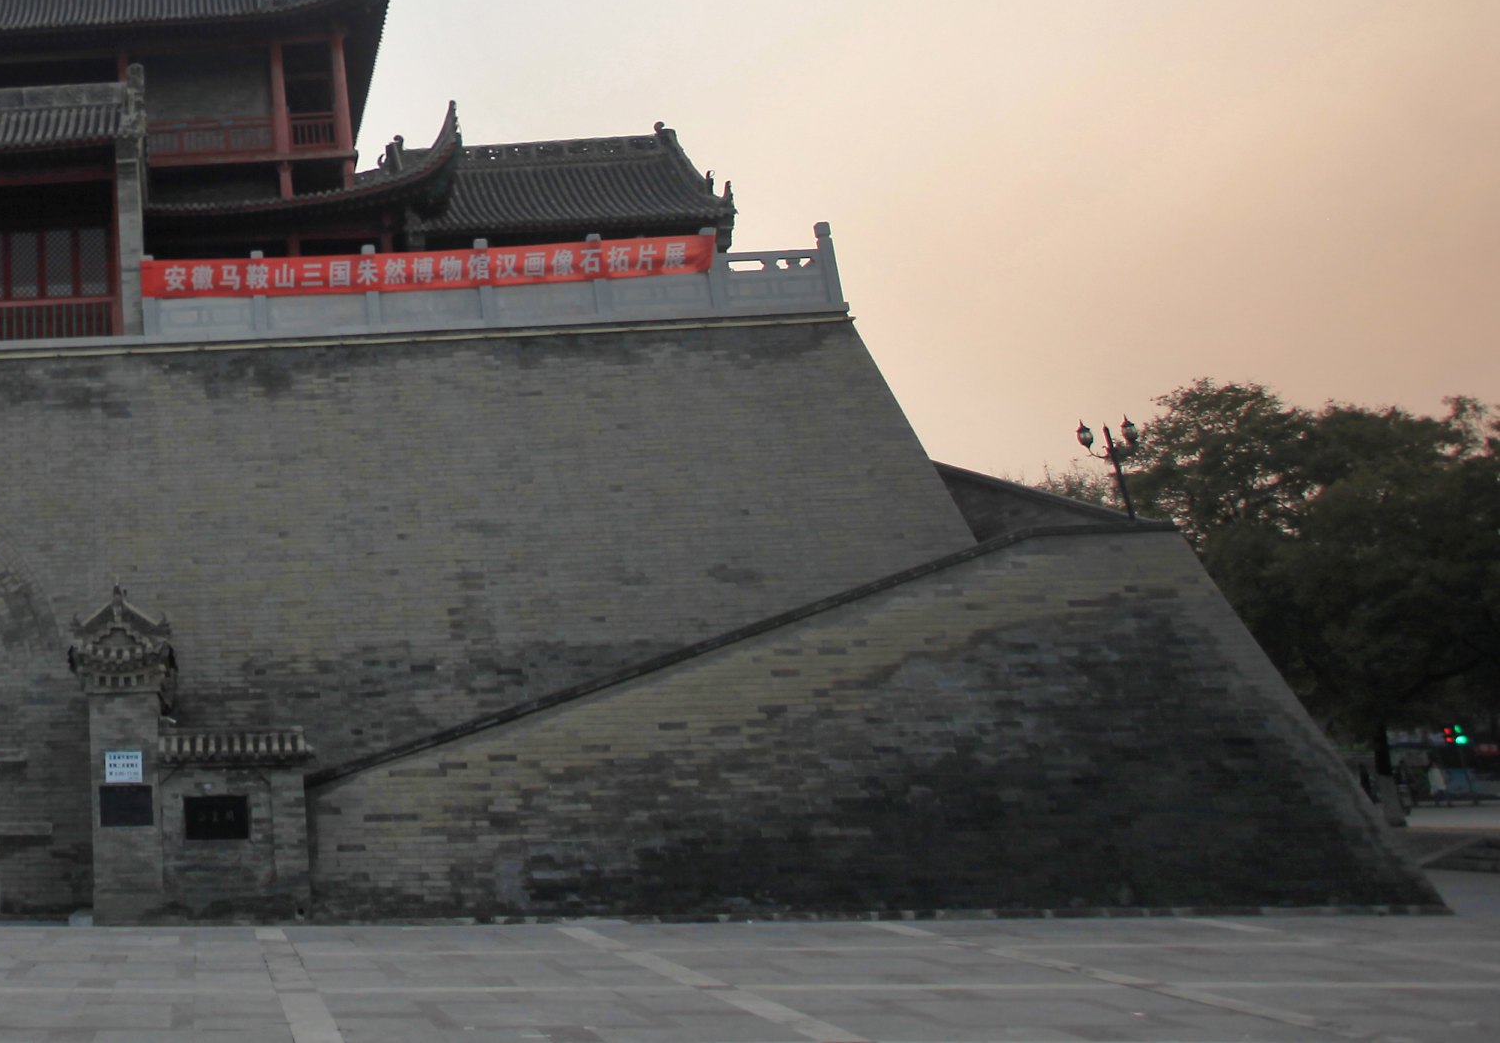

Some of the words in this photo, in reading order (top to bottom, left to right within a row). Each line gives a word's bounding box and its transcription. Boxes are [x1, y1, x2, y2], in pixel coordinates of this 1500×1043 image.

[164, 242, 687, 291] 安徽马鞍山三国朱然博物馆汉画像石拓片展
